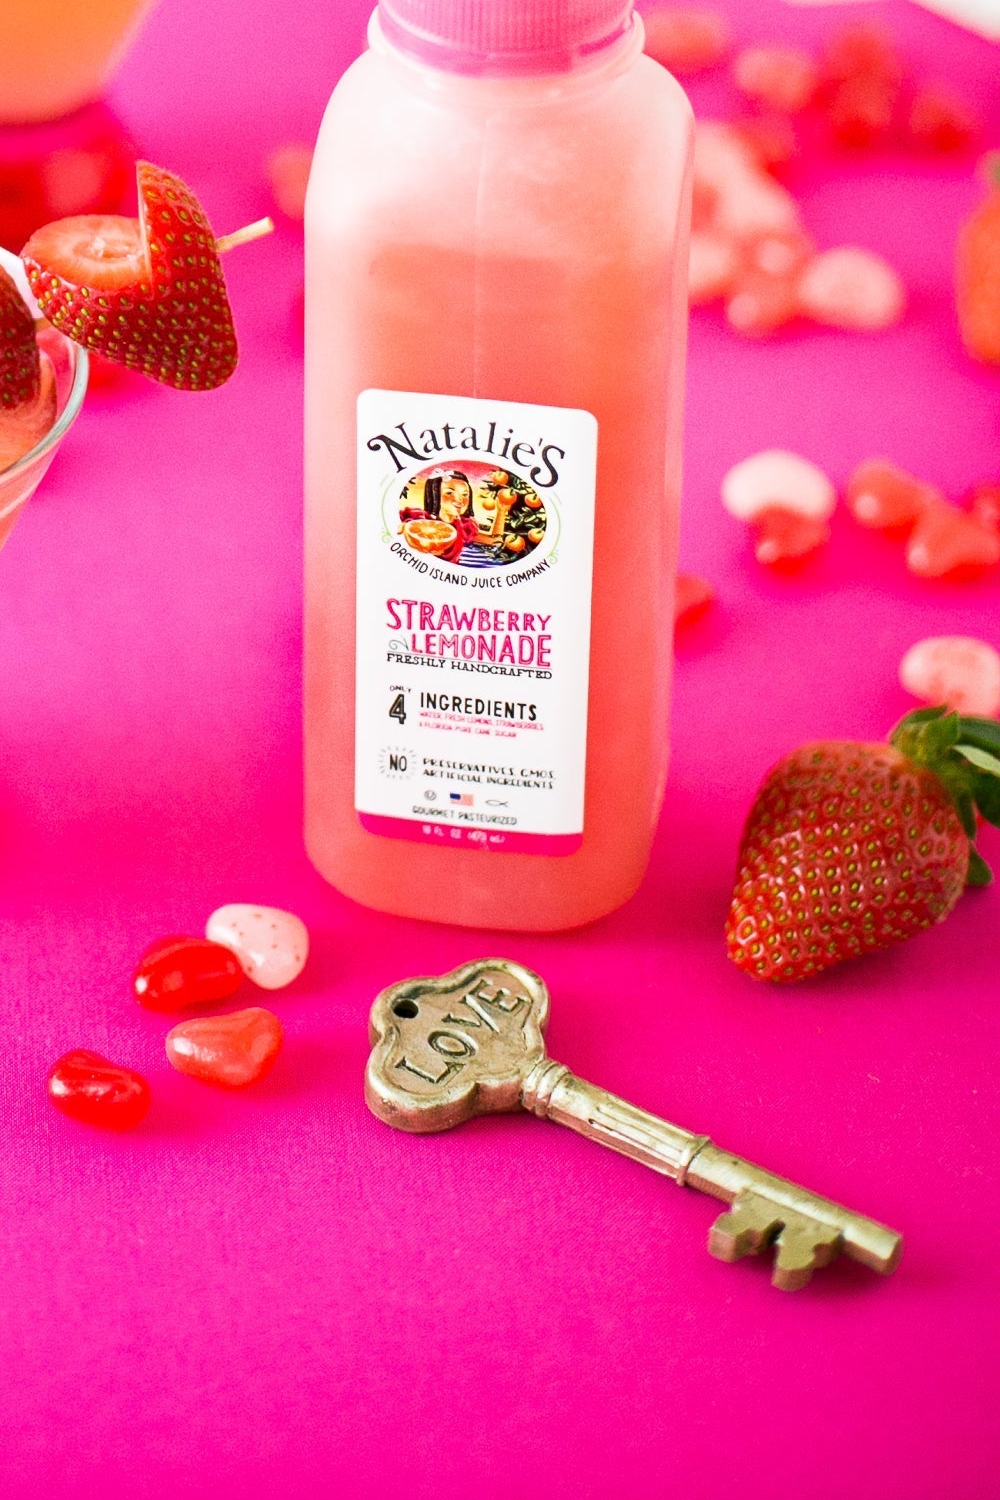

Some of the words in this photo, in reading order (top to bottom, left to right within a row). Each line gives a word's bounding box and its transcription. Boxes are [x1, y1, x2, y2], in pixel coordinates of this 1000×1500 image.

[390, 541, 429, 574] ORCHID
[429, 567, 468, 586] ISLAND
[471, 576, 503, 588] JUICE
[505, 558, 552, 587] COMPANY
[386, 597, 552, 632] STRAWBERRY
[411, 633, 552, 667] LEMONADE
[386, 652, 446, 669] FRESHLY
[451, 660, 553, 680] HANDCRAFTED
[389, 685, 412, 693] ONLY
[388, 693, 407, 725] 4
[420, 691, 537, 721] INGREDIENTS
[389, 753, 407, 772] NO
[422, 768, 482, 783] ARTIFICIAL
[486, 775, 554, 790] INGREDIENTS
[412, 805, 455, 819] GOURMET
[458, 811, 518, 826] PASTEURIZED
[394, 978, 534, 1086] LOVE
